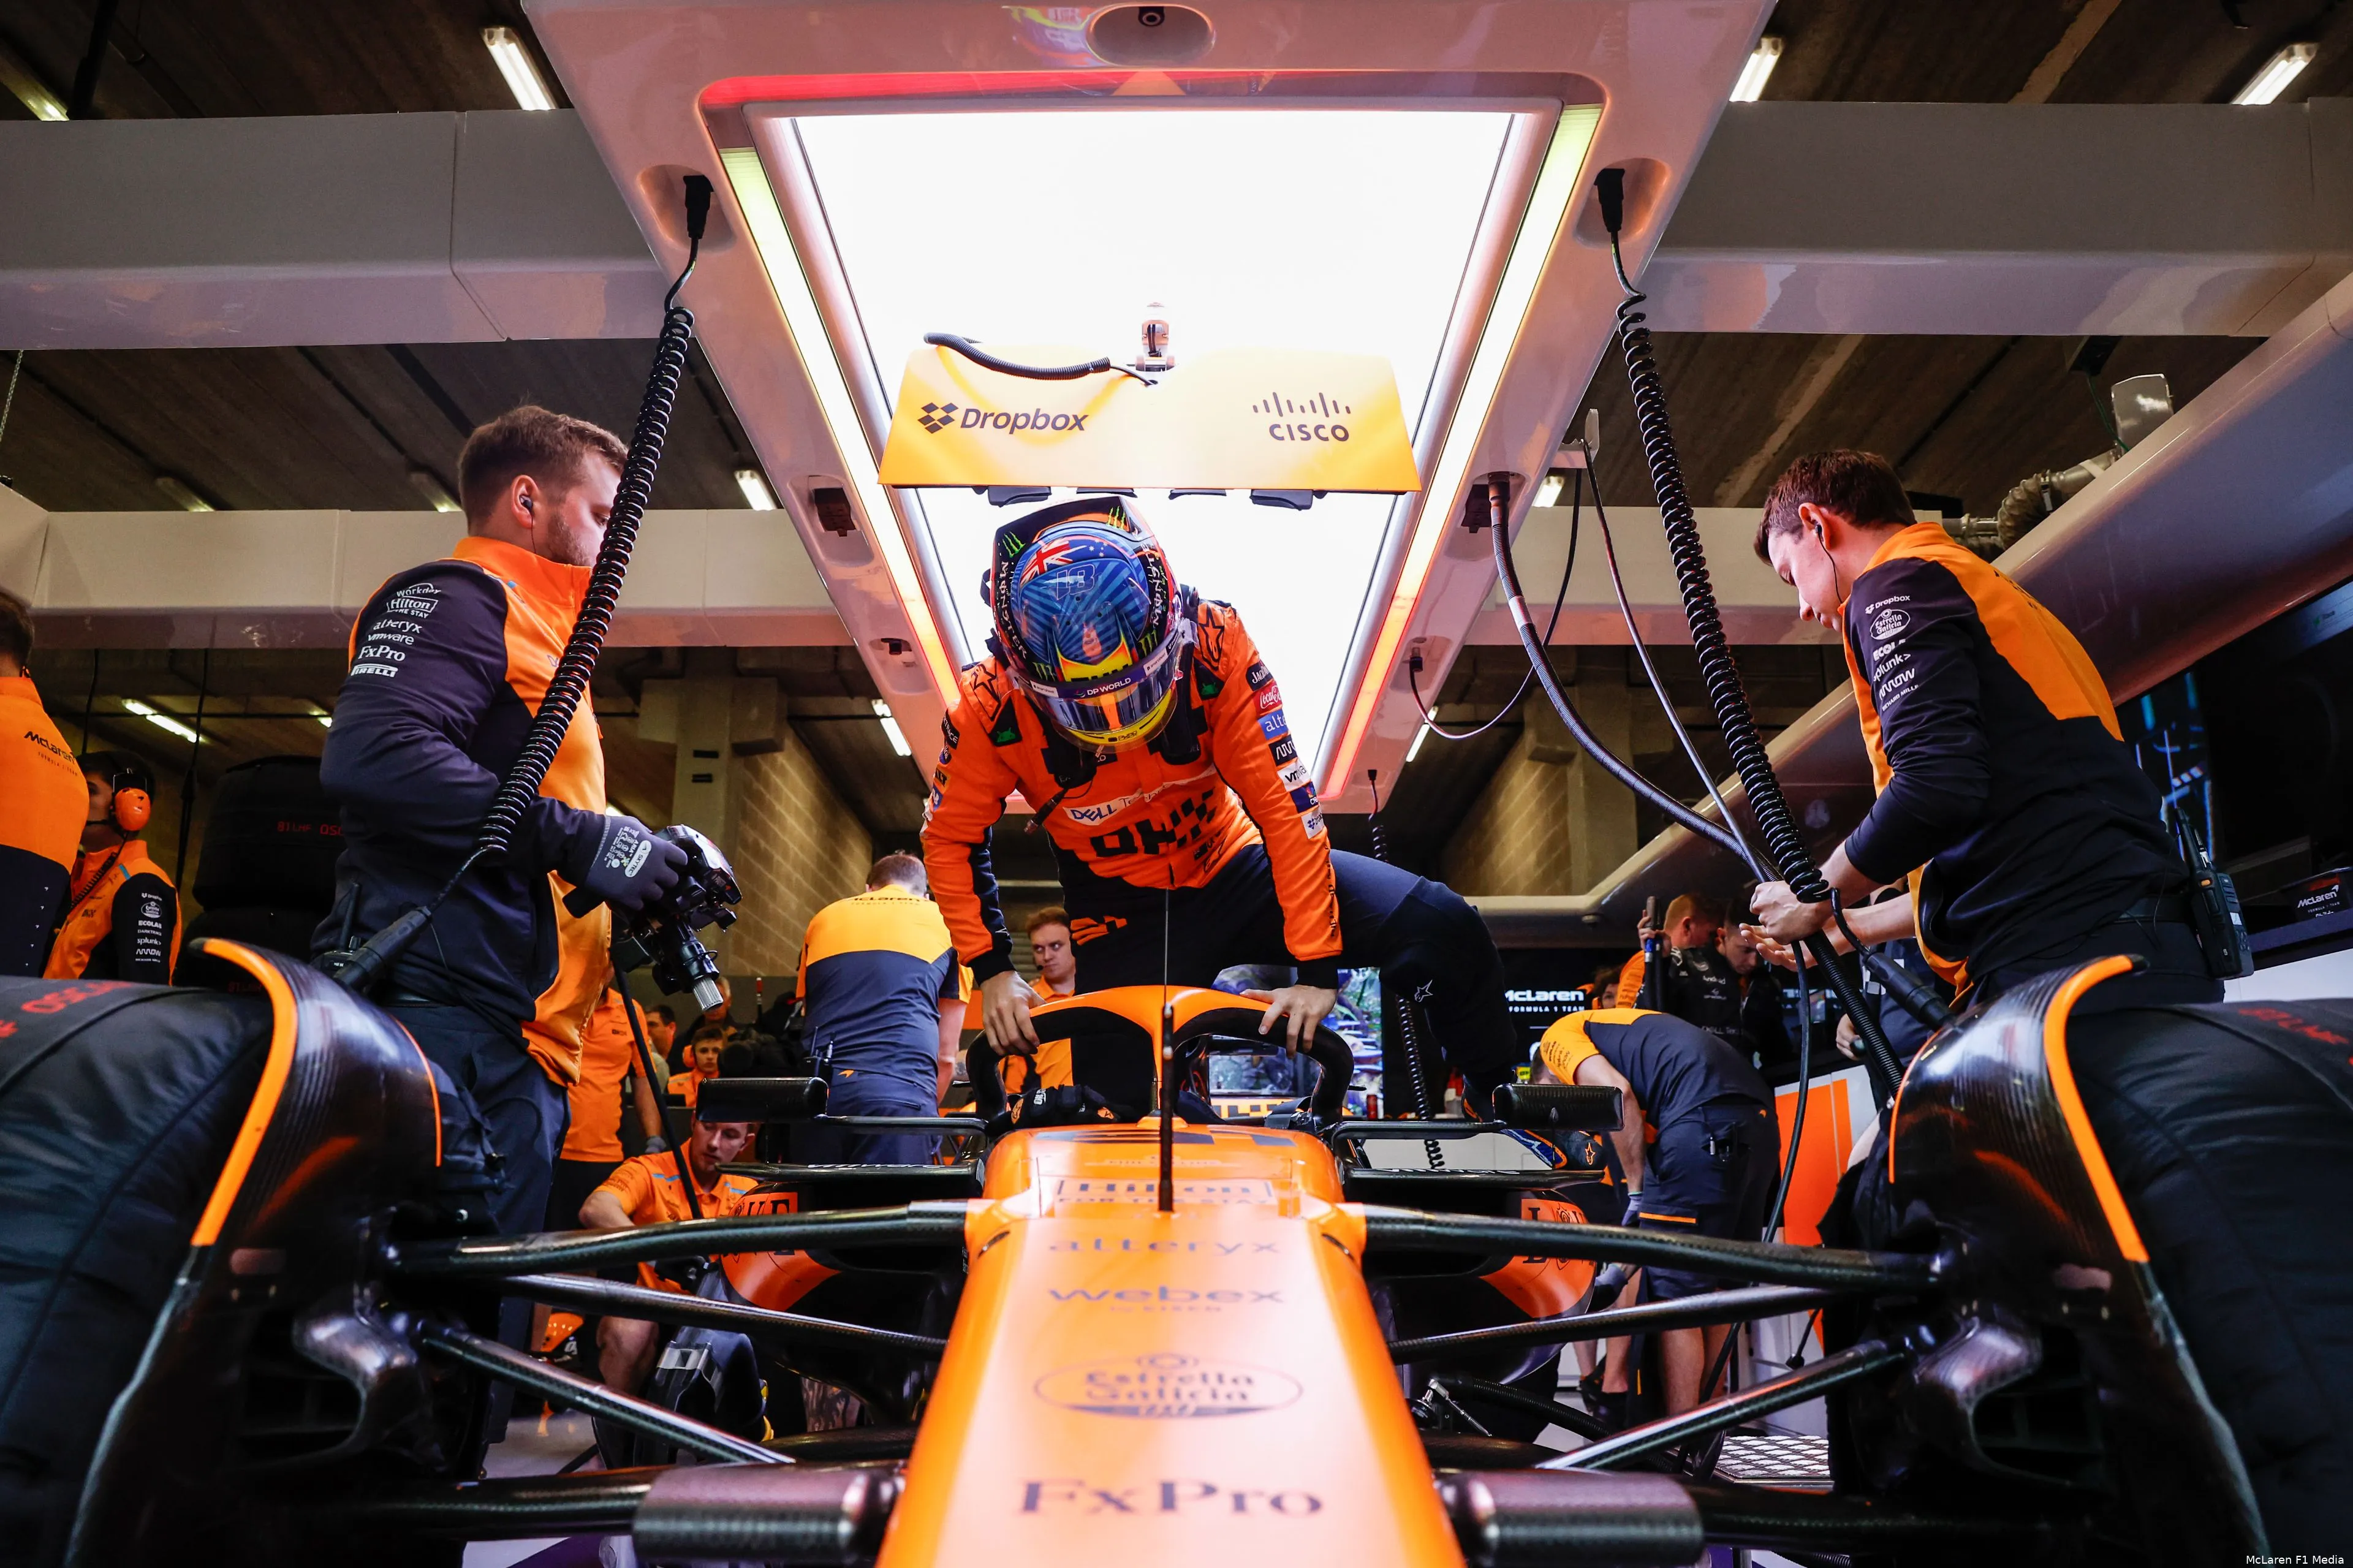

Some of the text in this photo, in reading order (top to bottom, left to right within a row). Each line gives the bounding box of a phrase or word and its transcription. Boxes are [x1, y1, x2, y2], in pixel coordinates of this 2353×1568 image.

[960, 409, 1089, 434] Dropbox
[1268, 423, 1350, 442] CISCO
[390, 598, 431, 609] Hilton
[1875, 596, 1911, 609] Dropbox
[410, 610, 429, 619] STAY
[1875, 615, 1902, 629] Estrella
[373, 619, 423, 634] alteryx
[1876, 621, 1901, 635] Galicia
[368, 633, 414, 645] vmware
[358, 645, 406, 661] FxPro
[1099, 678, 1131, 692] WORLD
[1265, 715, 1287, 732] alte
[24, 731, 75, 765] McLaren
[1070, 804, 1117, 821] DELL
[629, 854, 643, 874] SKYTEC
[2297, 891, 2338, 908] McLaren
[1077, 1183, 1254, 1194] Hilon
[1049, 1238, 1280, 1256] alteryx
[1047, 1285, 1284, 1301] webex
[1086, 1371, 1254, 1385] Estrella
[1020, 1478, 1324, 1517] FxPro
